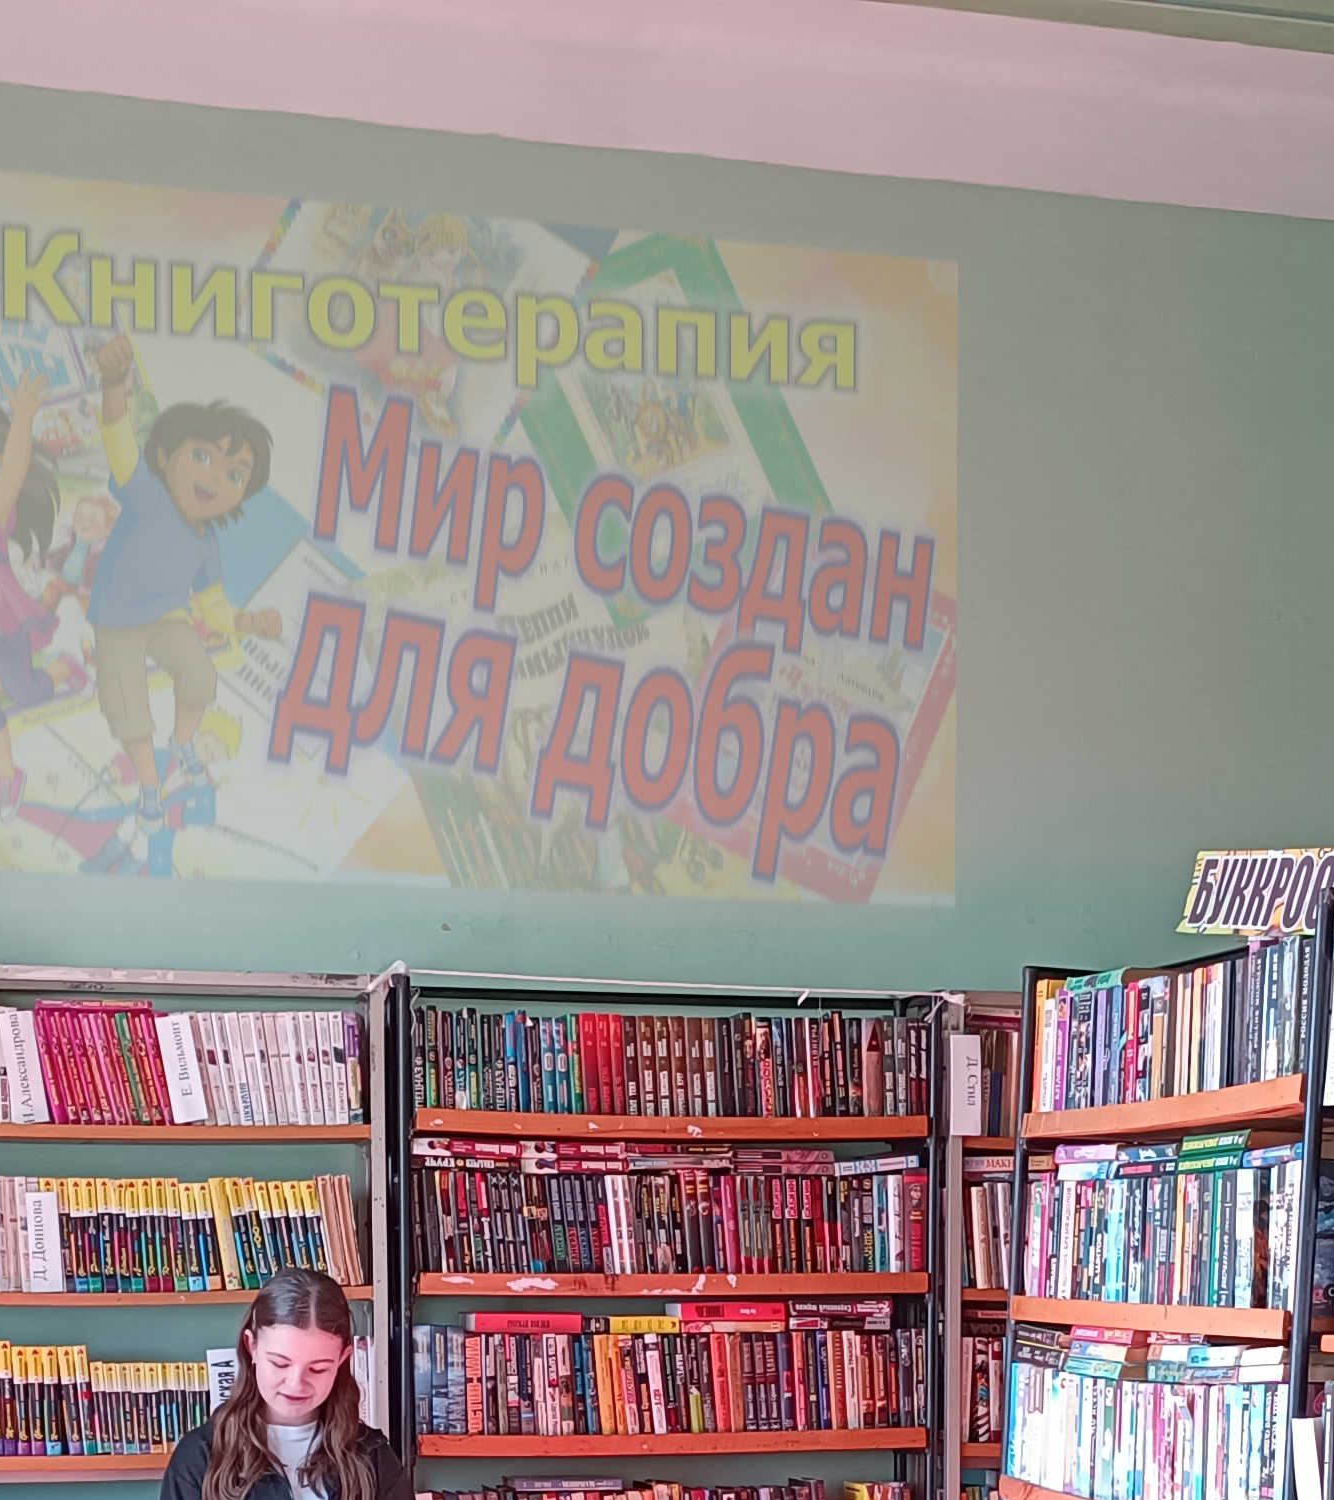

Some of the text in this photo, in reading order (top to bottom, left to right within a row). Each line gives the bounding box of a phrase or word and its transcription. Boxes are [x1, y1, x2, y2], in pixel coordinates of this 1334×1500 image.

[0, 225, 859, 392] Книготерапия
[309, 384, 936, 652] Мир создан
[267, 589, 905, 884] для добра
[171, 1021, 193, 1096] Е. Вильмонт
[966, 1056, 978, 1106] Д. Стил
[32, 1200, 47, 1281] Д. Донцова
